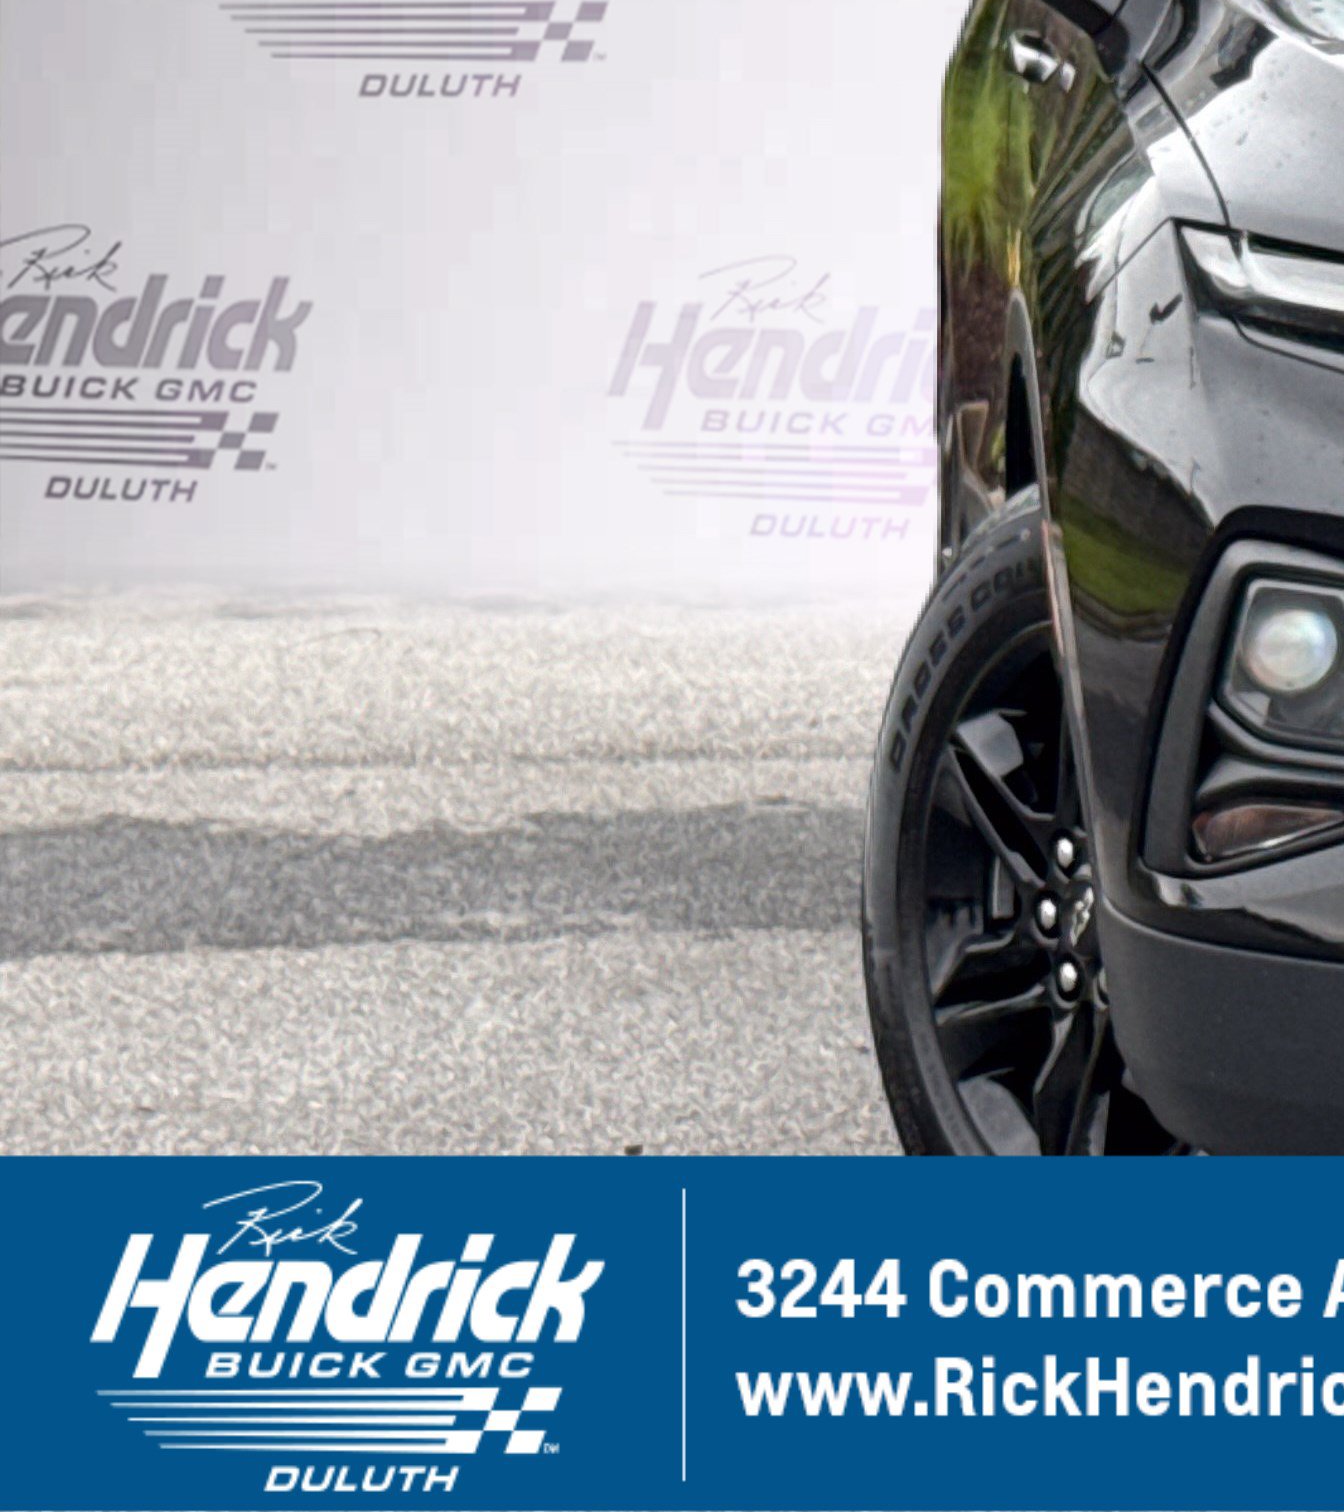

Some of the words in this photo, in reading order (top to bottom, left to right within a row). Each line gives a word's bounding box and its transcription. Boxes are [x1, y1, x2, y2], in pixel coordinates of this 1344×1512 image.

[358, 74, 522, 98] DULUTH
[0, 273, 313, 373] endrick
[0, 375, 139, 402] BUICK
[154, 378, 258, 405] GMC
[699, 410, 848, 435] BUICK
[44, 476, 198, 503] DULUTH
[750, 513, 910, 539] DULUTH
